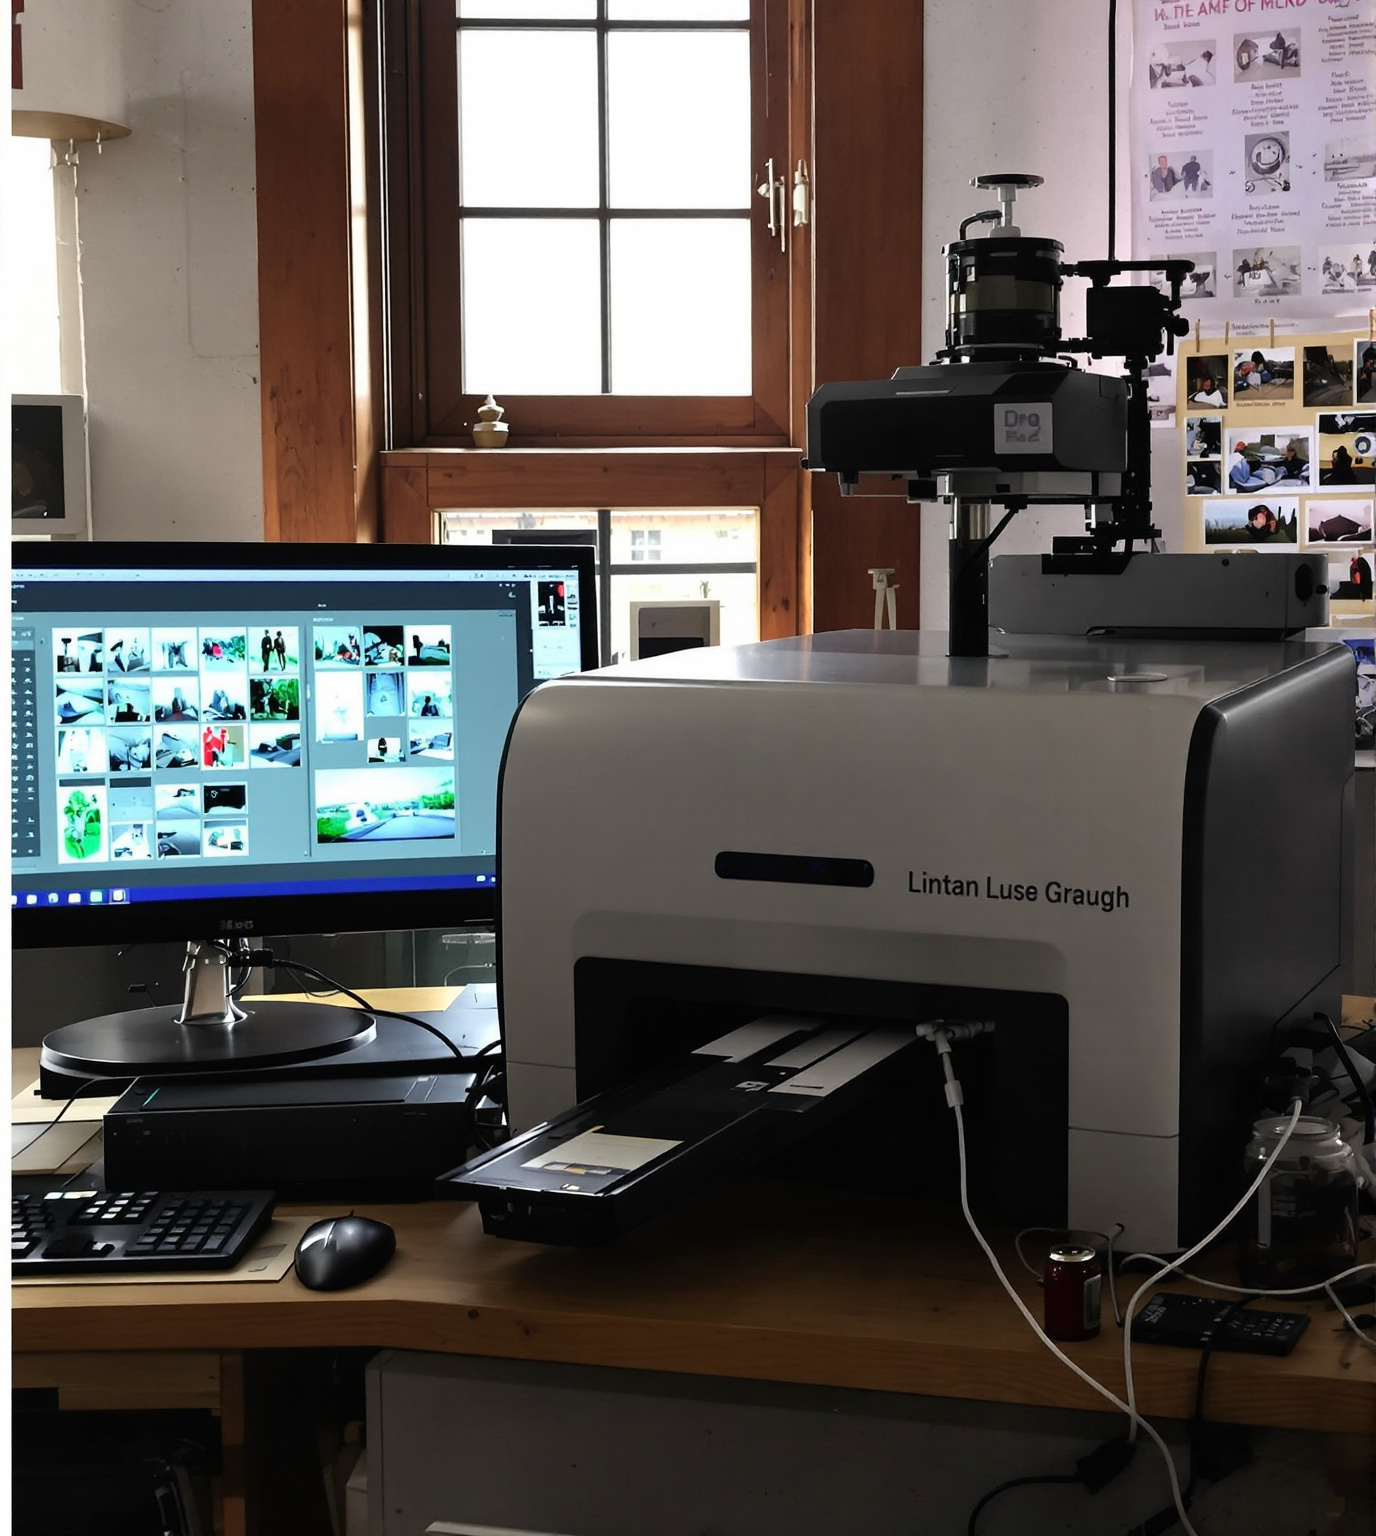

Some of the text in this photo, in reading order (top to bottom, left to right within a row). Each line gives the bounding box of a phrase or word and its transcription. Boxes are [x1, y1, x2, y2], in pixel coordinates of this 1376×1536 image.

[908, 870, 1130, 913] Lintan Luse Graugh
